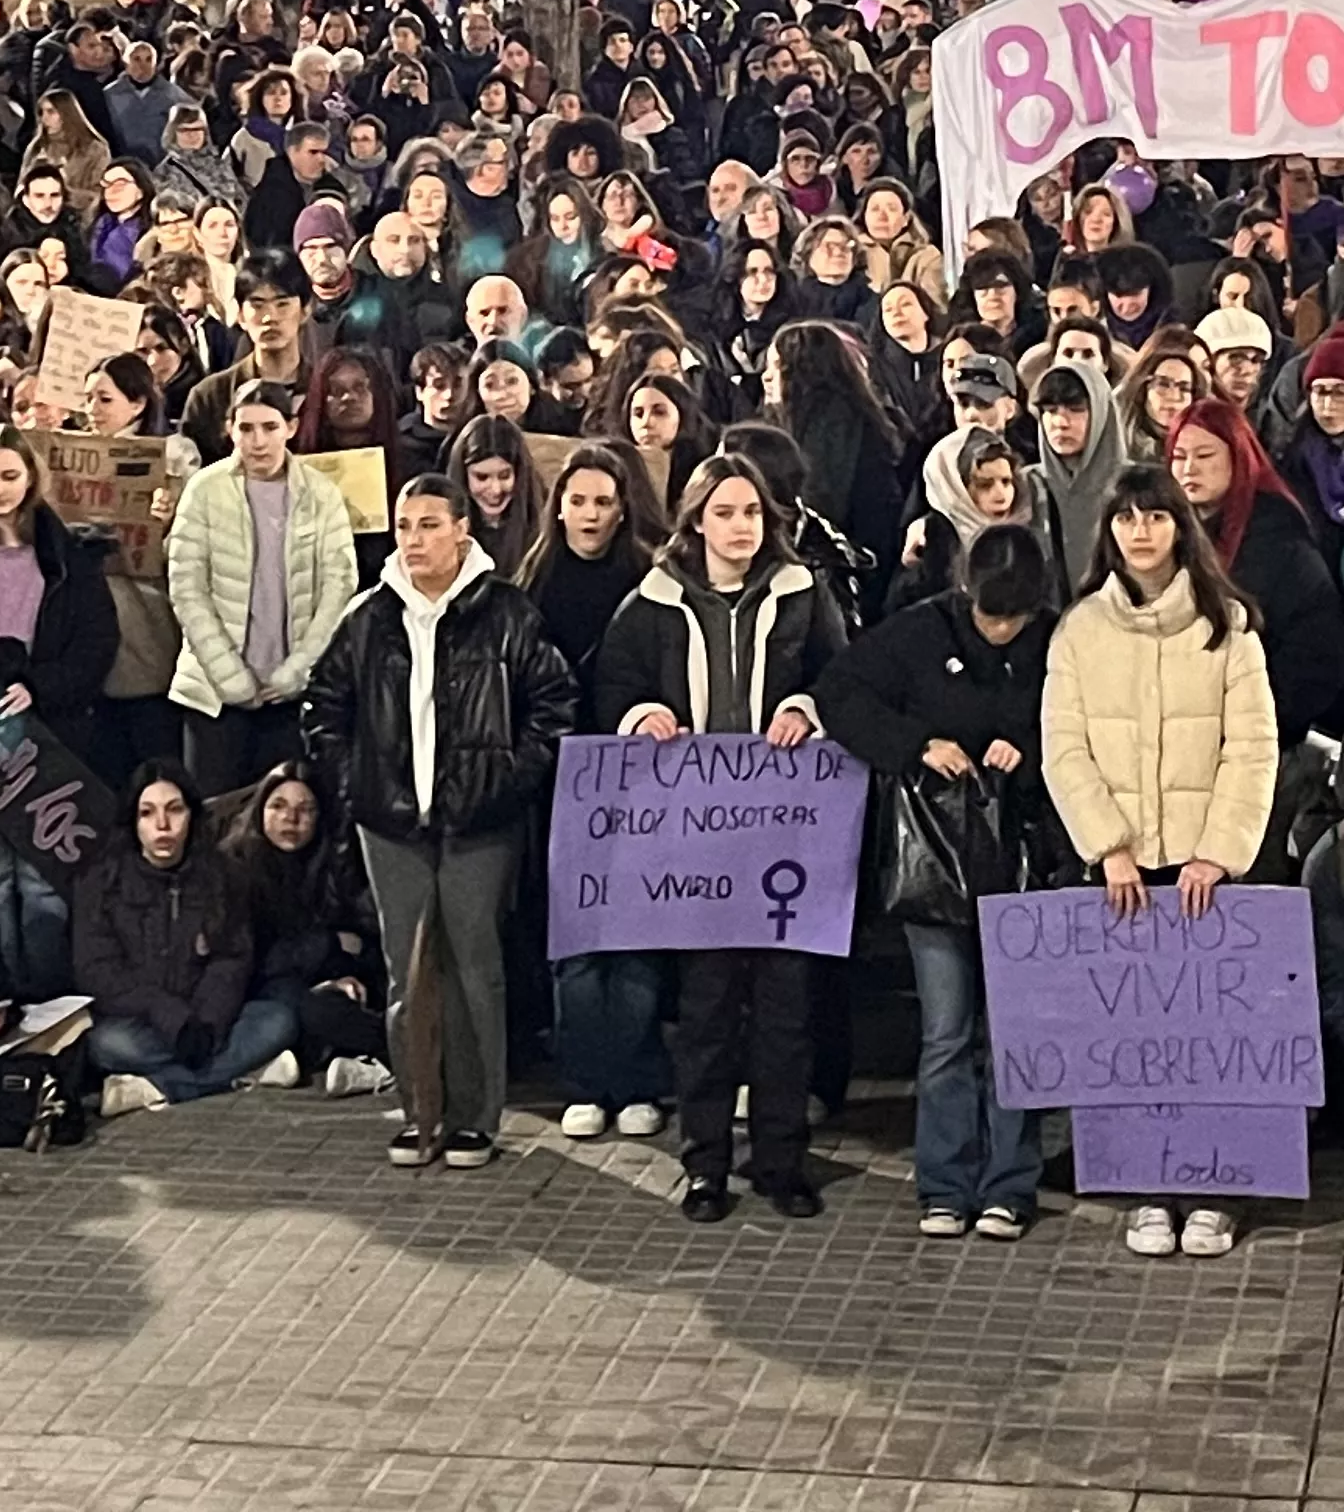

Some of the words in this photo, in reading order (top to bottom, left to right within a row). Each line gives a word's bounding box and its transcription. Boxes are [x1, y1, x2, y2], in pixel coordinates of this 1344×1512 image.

[984, 2, 1158, 165] 8M
[652, 740, 798, 789] CANSAS
[814, 747, 848, 782] DE
[683, 804, 819, 837] NOSOTRAS
[996, 898, 1261, 961] QUEREMOS
[1087, 958, 1254, 1018] VIVIR
[1004, 1039, 1067, 1093] NO
[1086, 1035, 1318, 1089] SOBREVIVIR
[1160, 1136, 1255, 1185] todos
